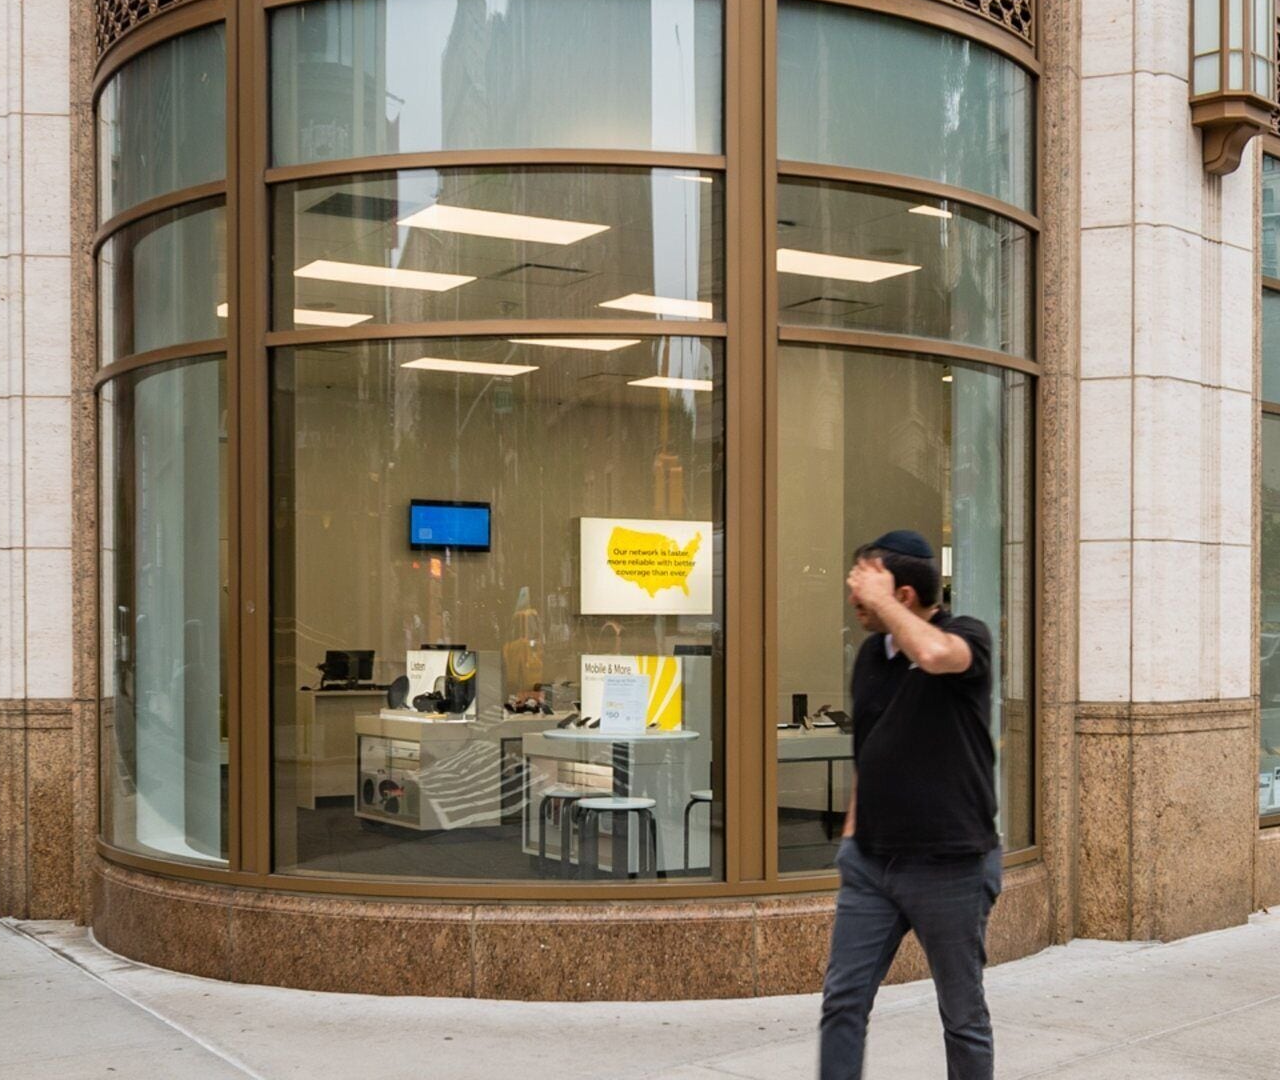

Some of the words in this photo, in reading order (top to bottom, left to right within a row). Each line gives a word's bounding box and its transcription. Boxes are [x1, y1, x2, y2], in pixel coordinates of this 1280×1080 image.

[613, 548, 628, 556] Our
[629, 548, 658, 557] network
[628, 558, 655, 567] reliable
[657, 559, 672, 567] with
[674, 559, 696, 567] better
[616, 569, 650, 577] coverage
[584, 663, 606, 674] Mobile
[608, 664, 613, 674] &
[614, 664, 632, 675] More
